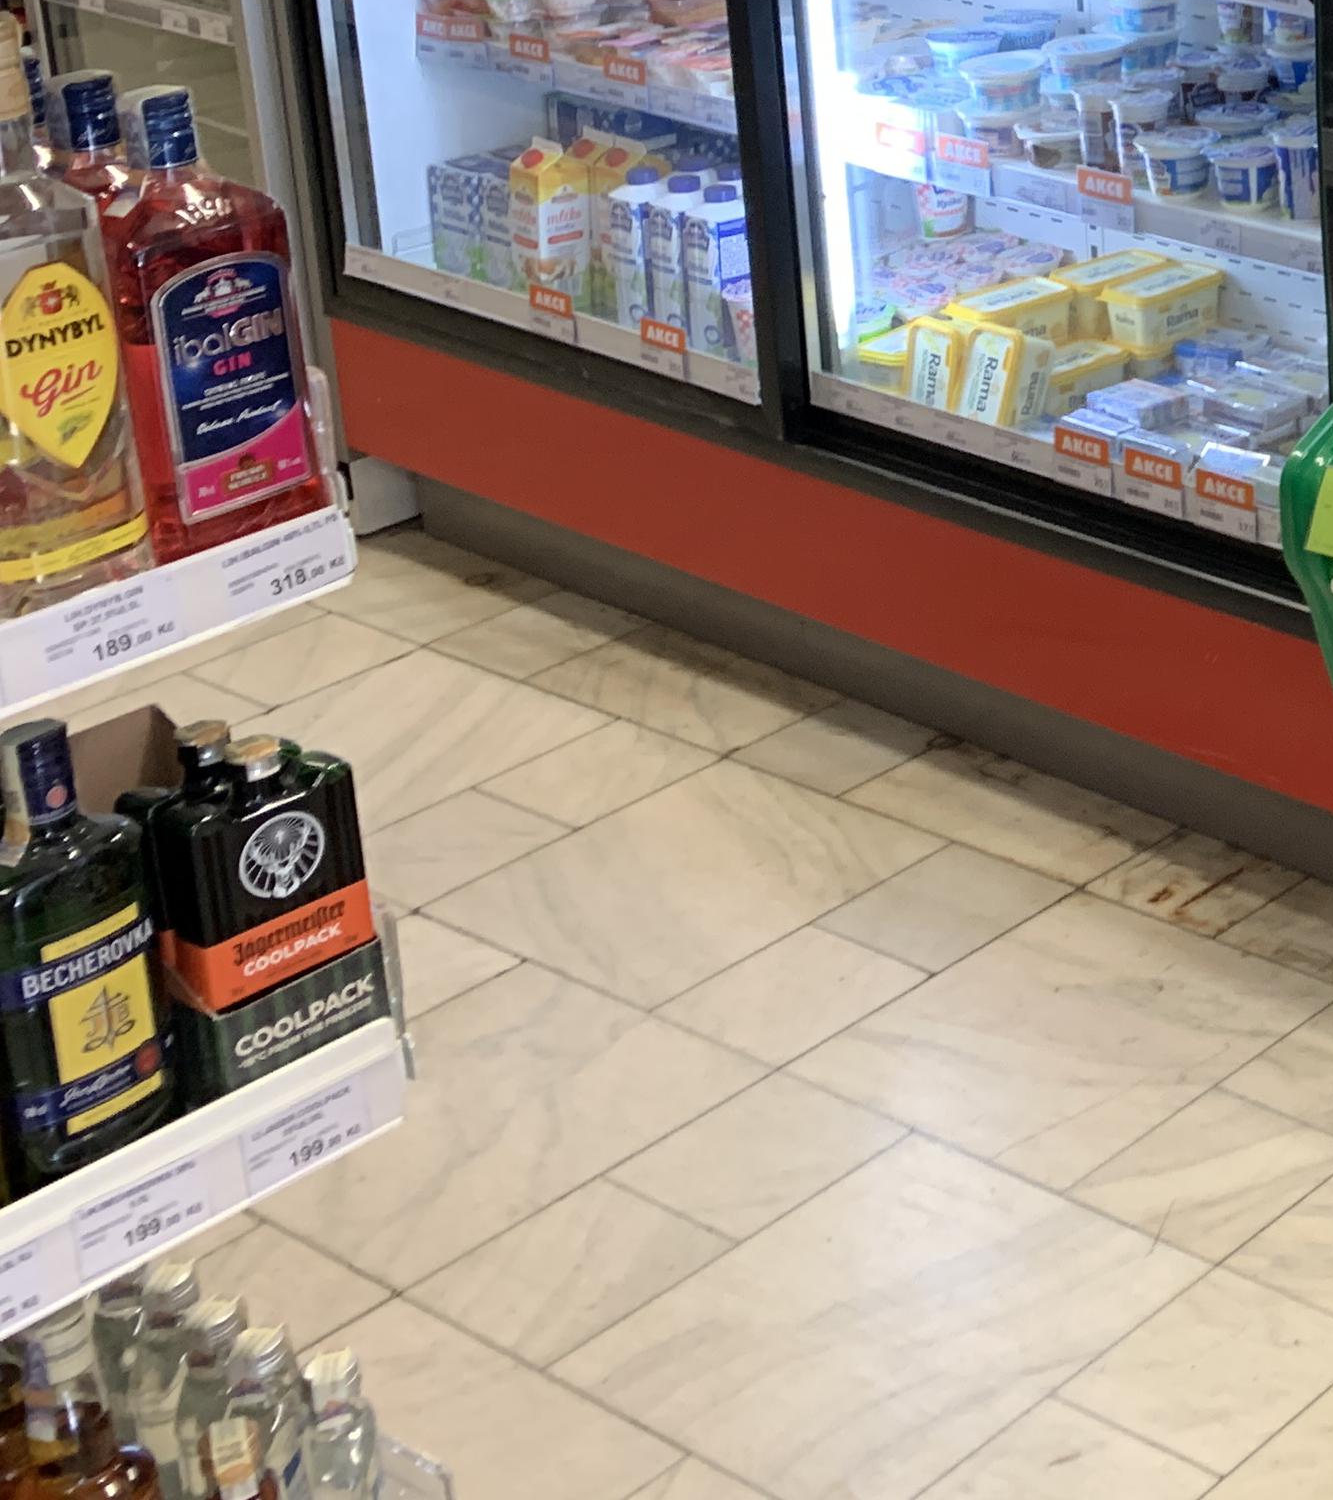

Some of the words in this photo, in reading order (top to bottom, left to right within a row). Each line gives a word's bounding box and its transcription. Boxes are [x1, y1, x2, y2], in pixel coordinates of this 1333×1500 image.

[514, 40, 543, 59] AKCE
[608, 61, 640, 82] AKCE
[943, 141, 982, 163] AKCE
[1084, 175, 1125, 198] AKCE
[536, 290, 567, 311] AKCE
[1166, 308, 1199, 329] Rama
[173, 308, 284, 366] ibalGIN
[646, 324, 680, 346] AKCE
[212, 352, 253, 377] GIN
[20, 360, 103, 418] Gin
[925, 353, 942, 406] Rama
[976, 356, 998, 412] Rama
[1020, 372, 1040, 416] Rama
[1061, 435, 1104, 459] AKCE
[1132, 457, 1175, 481] AKCE
[1203, 477, 1248, 502] AKCE
[21, 916, 154, 1000] BECHEROVKA
[243, 922, 343, 978] COOLPACK
[235, 972, 376, 1058] COOLPACK
